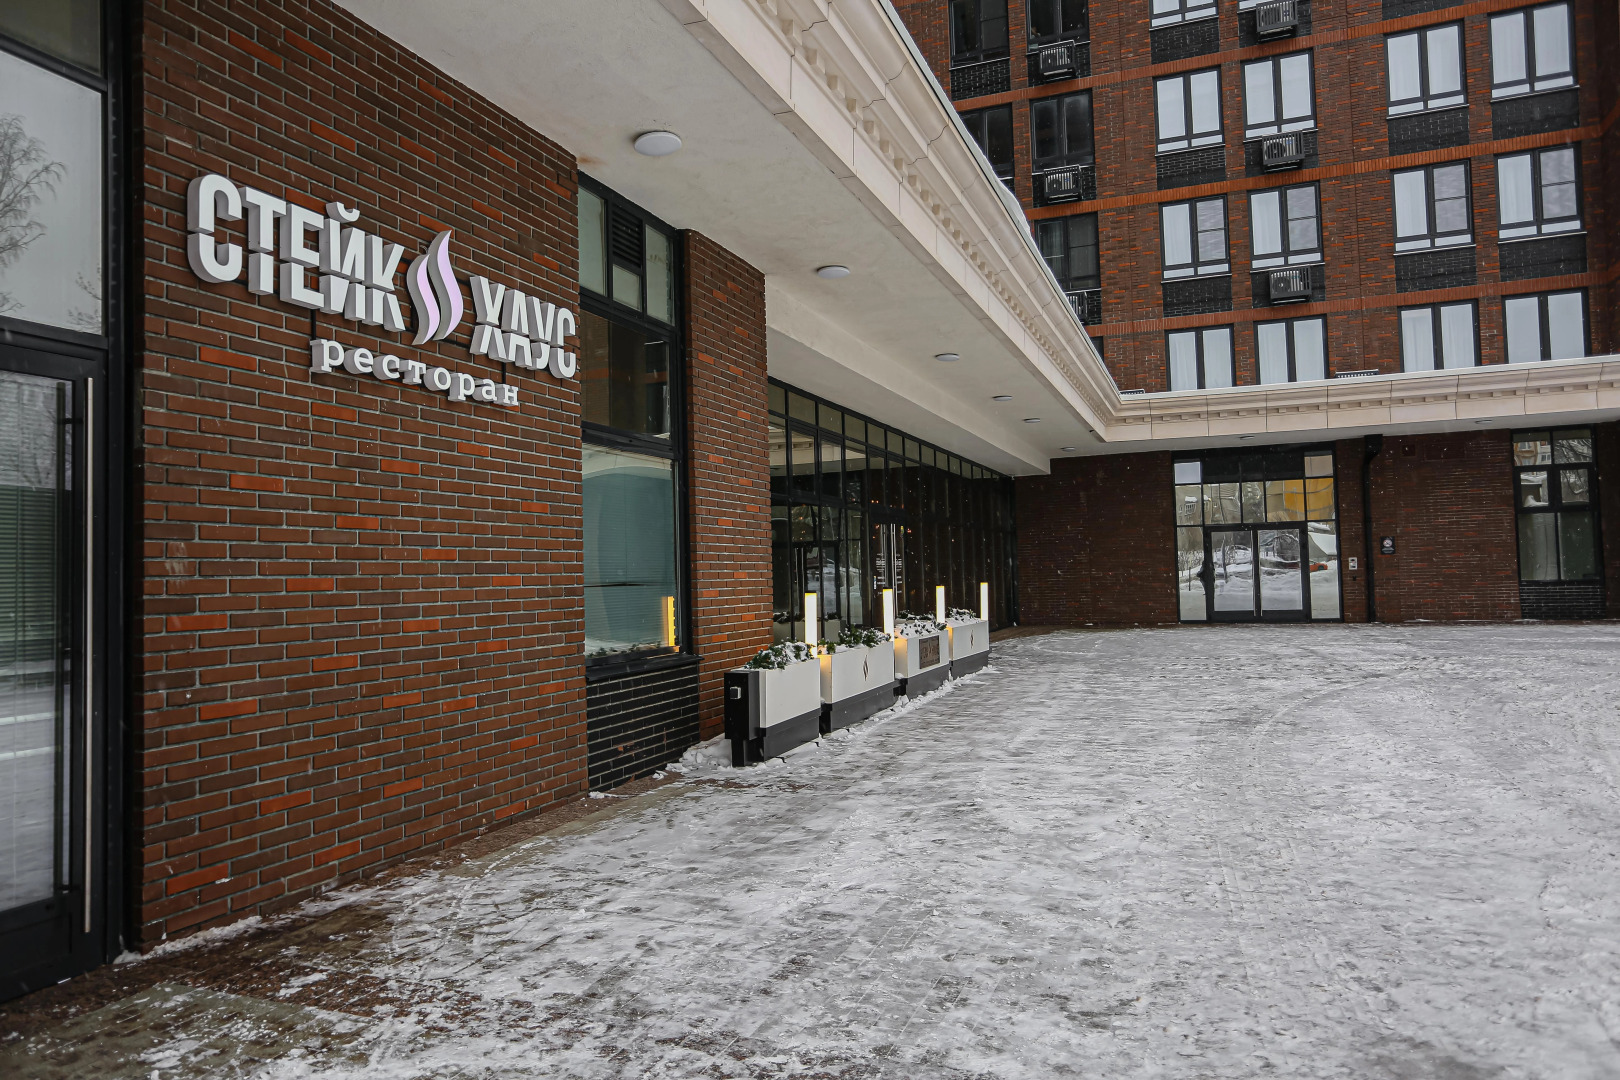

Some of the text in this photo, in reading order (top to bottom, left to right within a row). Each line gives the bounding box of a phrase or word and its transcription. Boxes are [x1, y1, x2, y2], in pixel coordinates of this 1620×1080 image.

[187, 174, 577, 379] СТЕЙК ХАУС
[310, 339, 520, 407] ресторан
